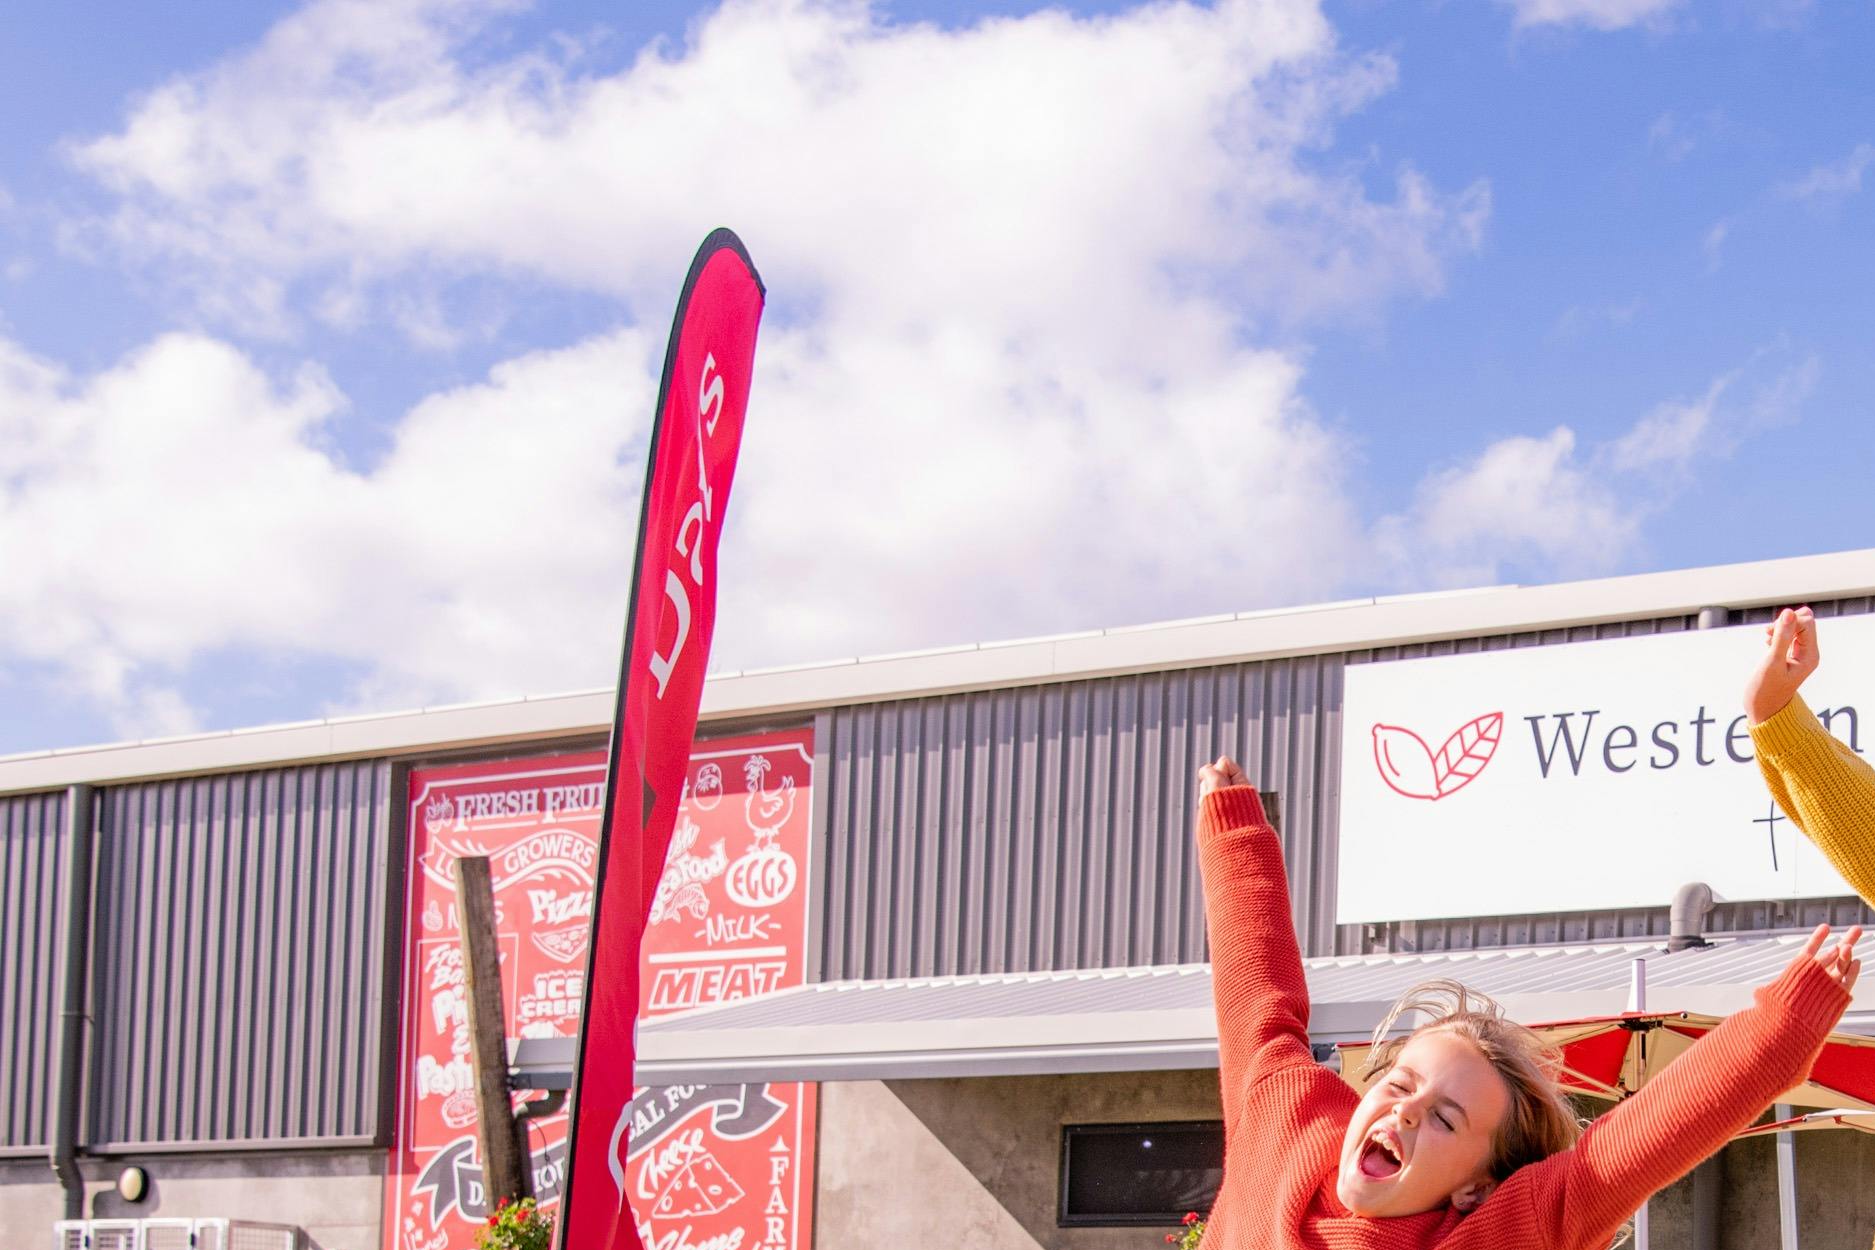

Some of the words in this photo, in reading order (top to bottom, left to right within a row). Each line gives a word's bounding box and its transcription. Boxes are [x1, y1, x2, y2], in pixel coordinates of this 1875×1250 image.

[1523, 706, 1864, 779] Westen
[453, 788, 540, 832] FRESH
[542, 782, 606, 823] FRUI
[503, 834, 596, 873] GROWERS
[733, 857, 789, 902] EGGS
[527, 888, 593, 925] Pizz
[535, 976, 583, 999] ICE
[648, 961, 787, 1011] MEAT
[637, 1128, 706, 1199] Cheese
